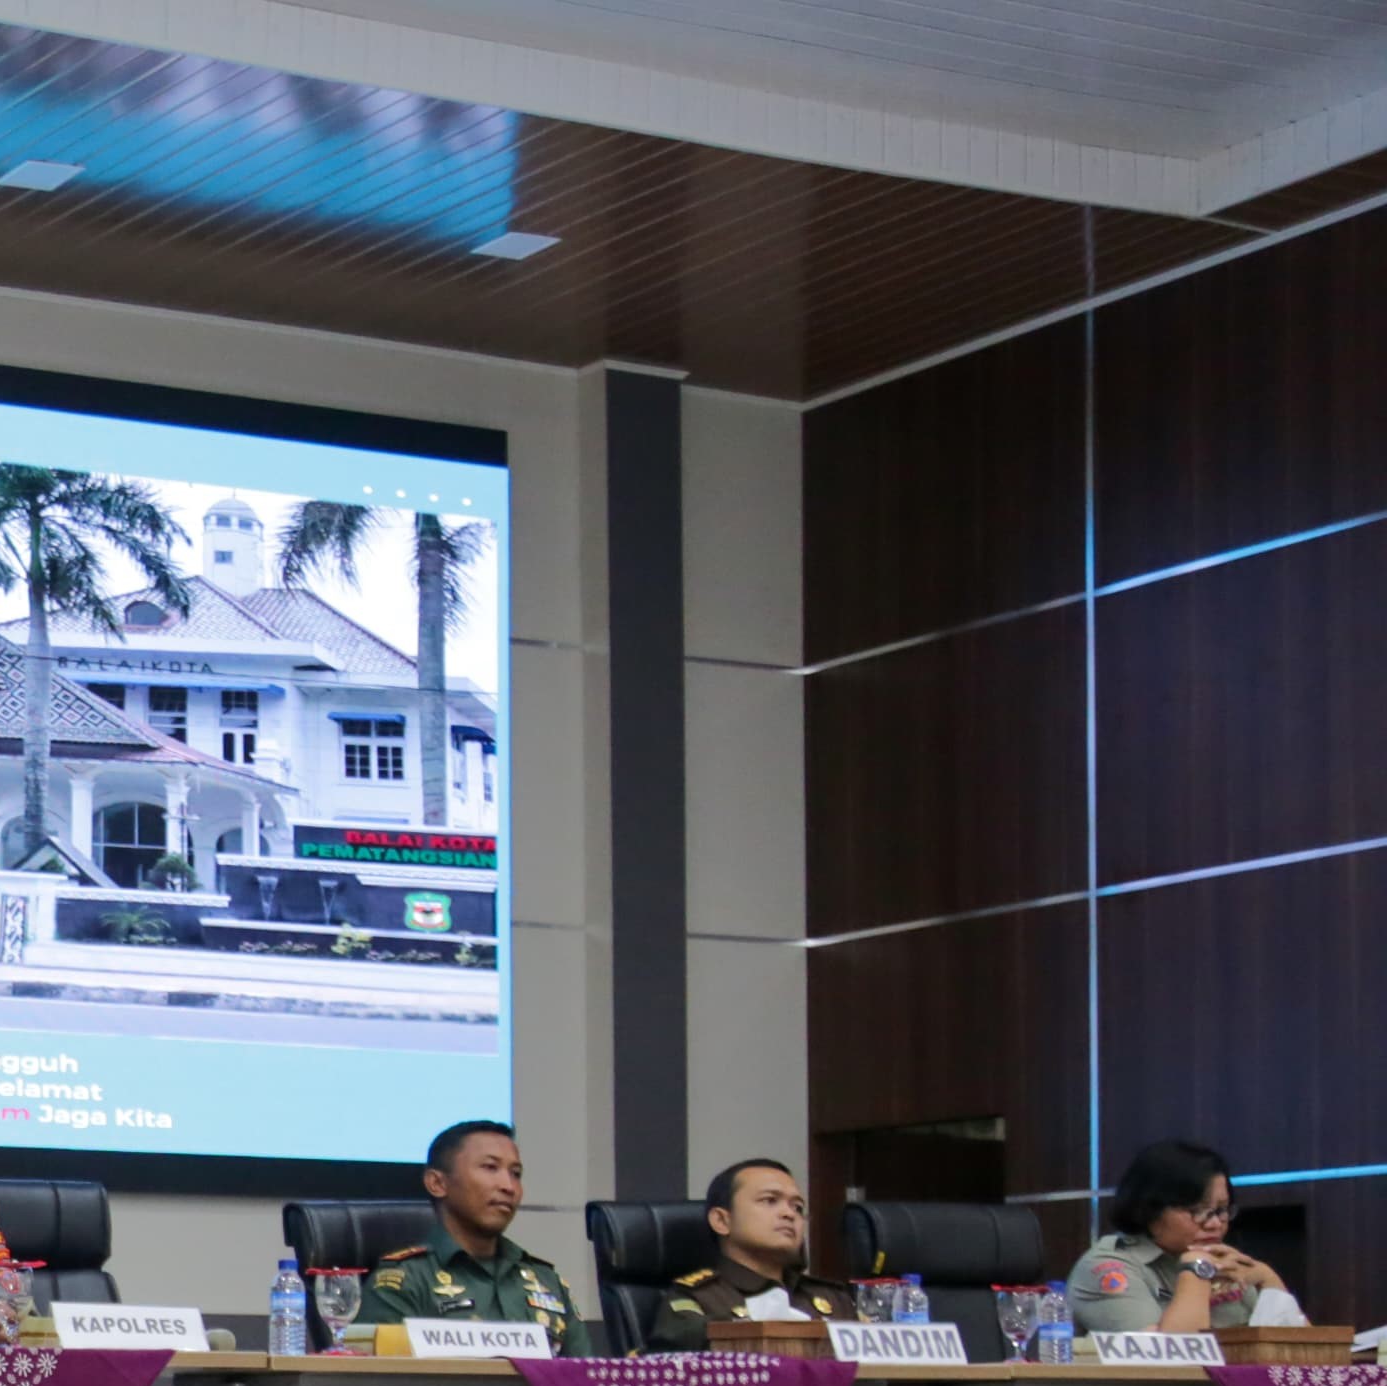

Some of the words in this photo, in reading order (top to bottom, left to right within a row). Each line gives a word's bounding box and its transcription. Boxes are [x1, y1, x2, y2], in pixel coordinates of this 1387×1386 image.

[344, 830, 423, 848] BALAI
[38, 1104, 107, 1128] Jaga
[115, 1108, 173, 1129] Kita
[71, 1316, 187, 1335] KAPOLRES
[422, 1330, 474, 1347] WALI
[480, 1331, 538, 1348] KOTA
[837, 1328, 961, 1358] DANDIM
[1095, 1335, 1221, 1362] KAJARI
